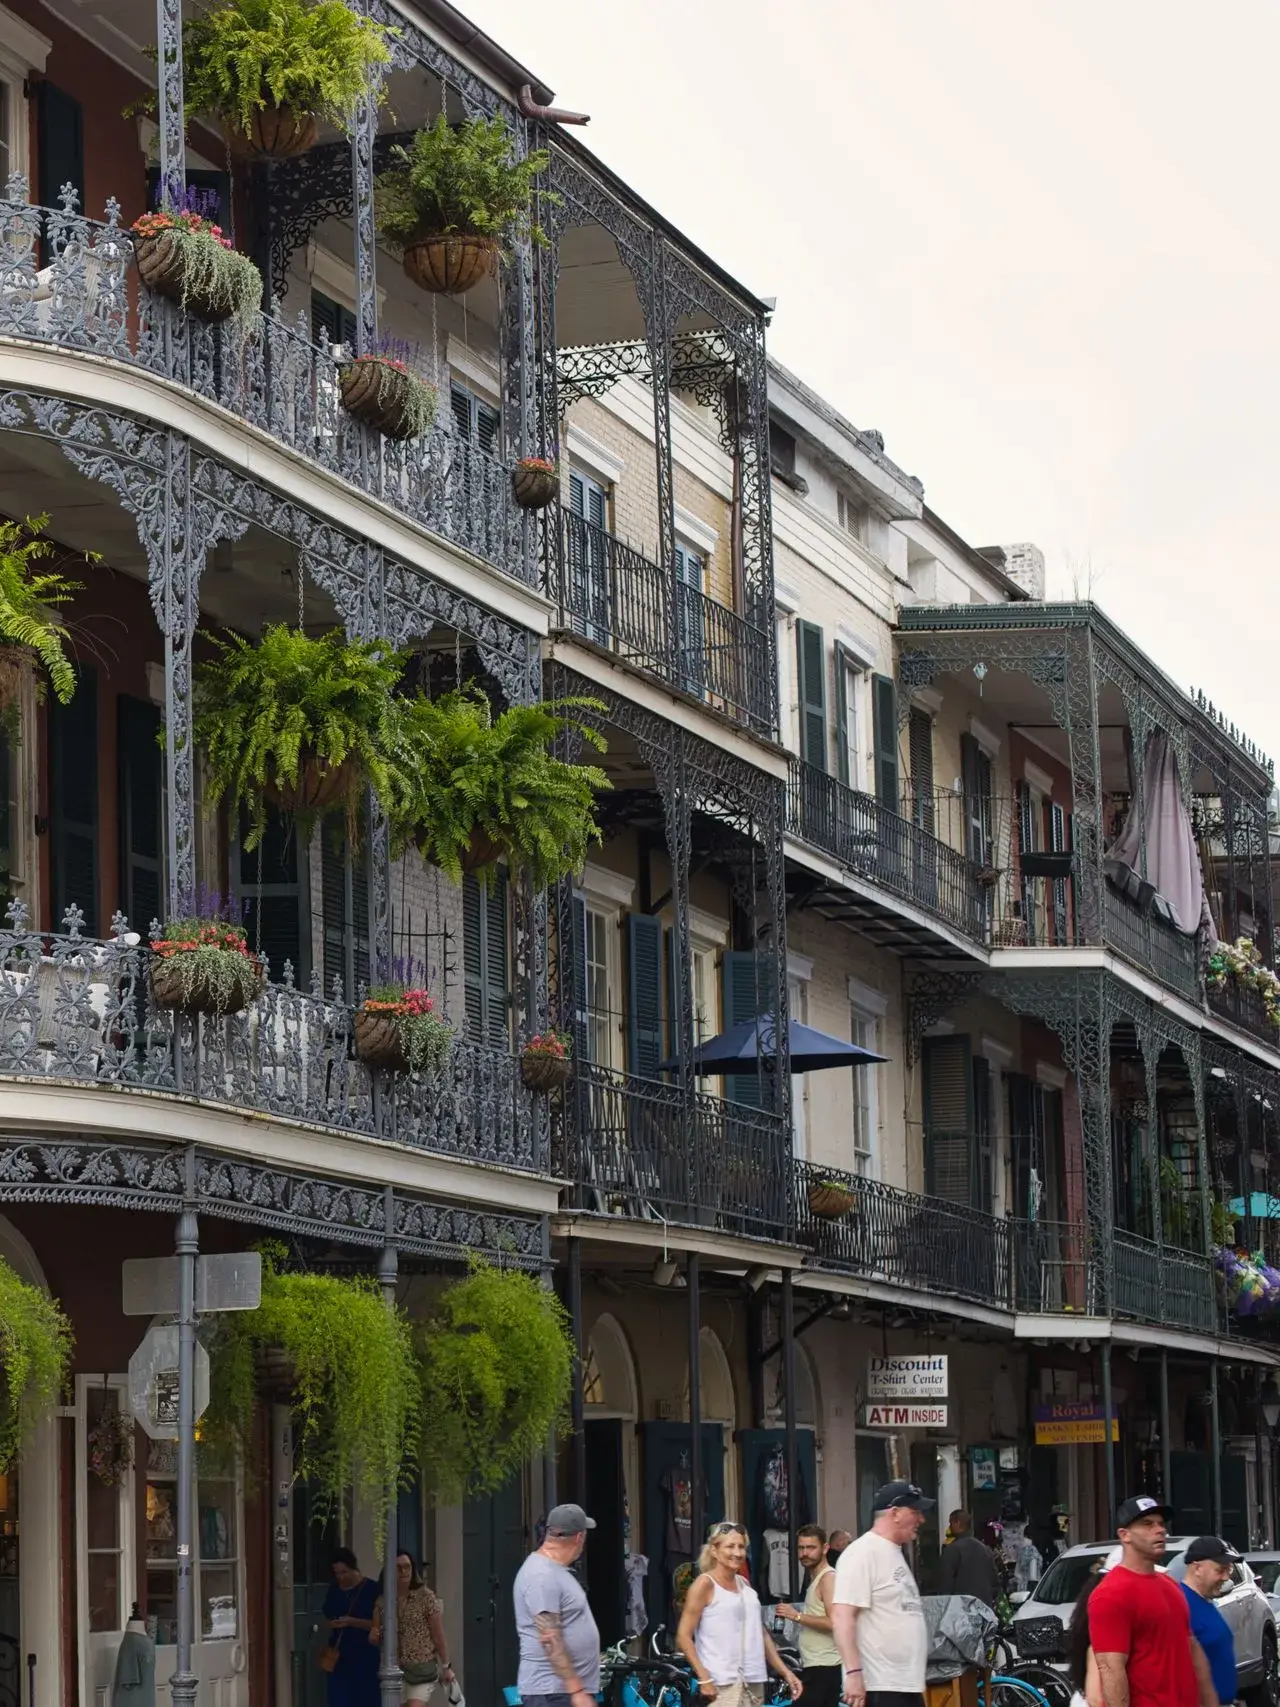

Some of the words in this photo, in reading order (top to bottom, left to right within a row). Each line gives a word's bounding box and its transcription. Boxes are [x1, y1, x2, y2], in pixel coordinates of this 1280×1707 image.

[871, 1357, 945, 1372] Discount
[871, 1373, 907, 1385] T-Shirt
[913, 1374, 945, 1385] Center
[869, 1407, 909, 1424] ATM
[912, 1409, 945, 1423] INSIDE
[1052, 1403, 1094, 1419] Royal
